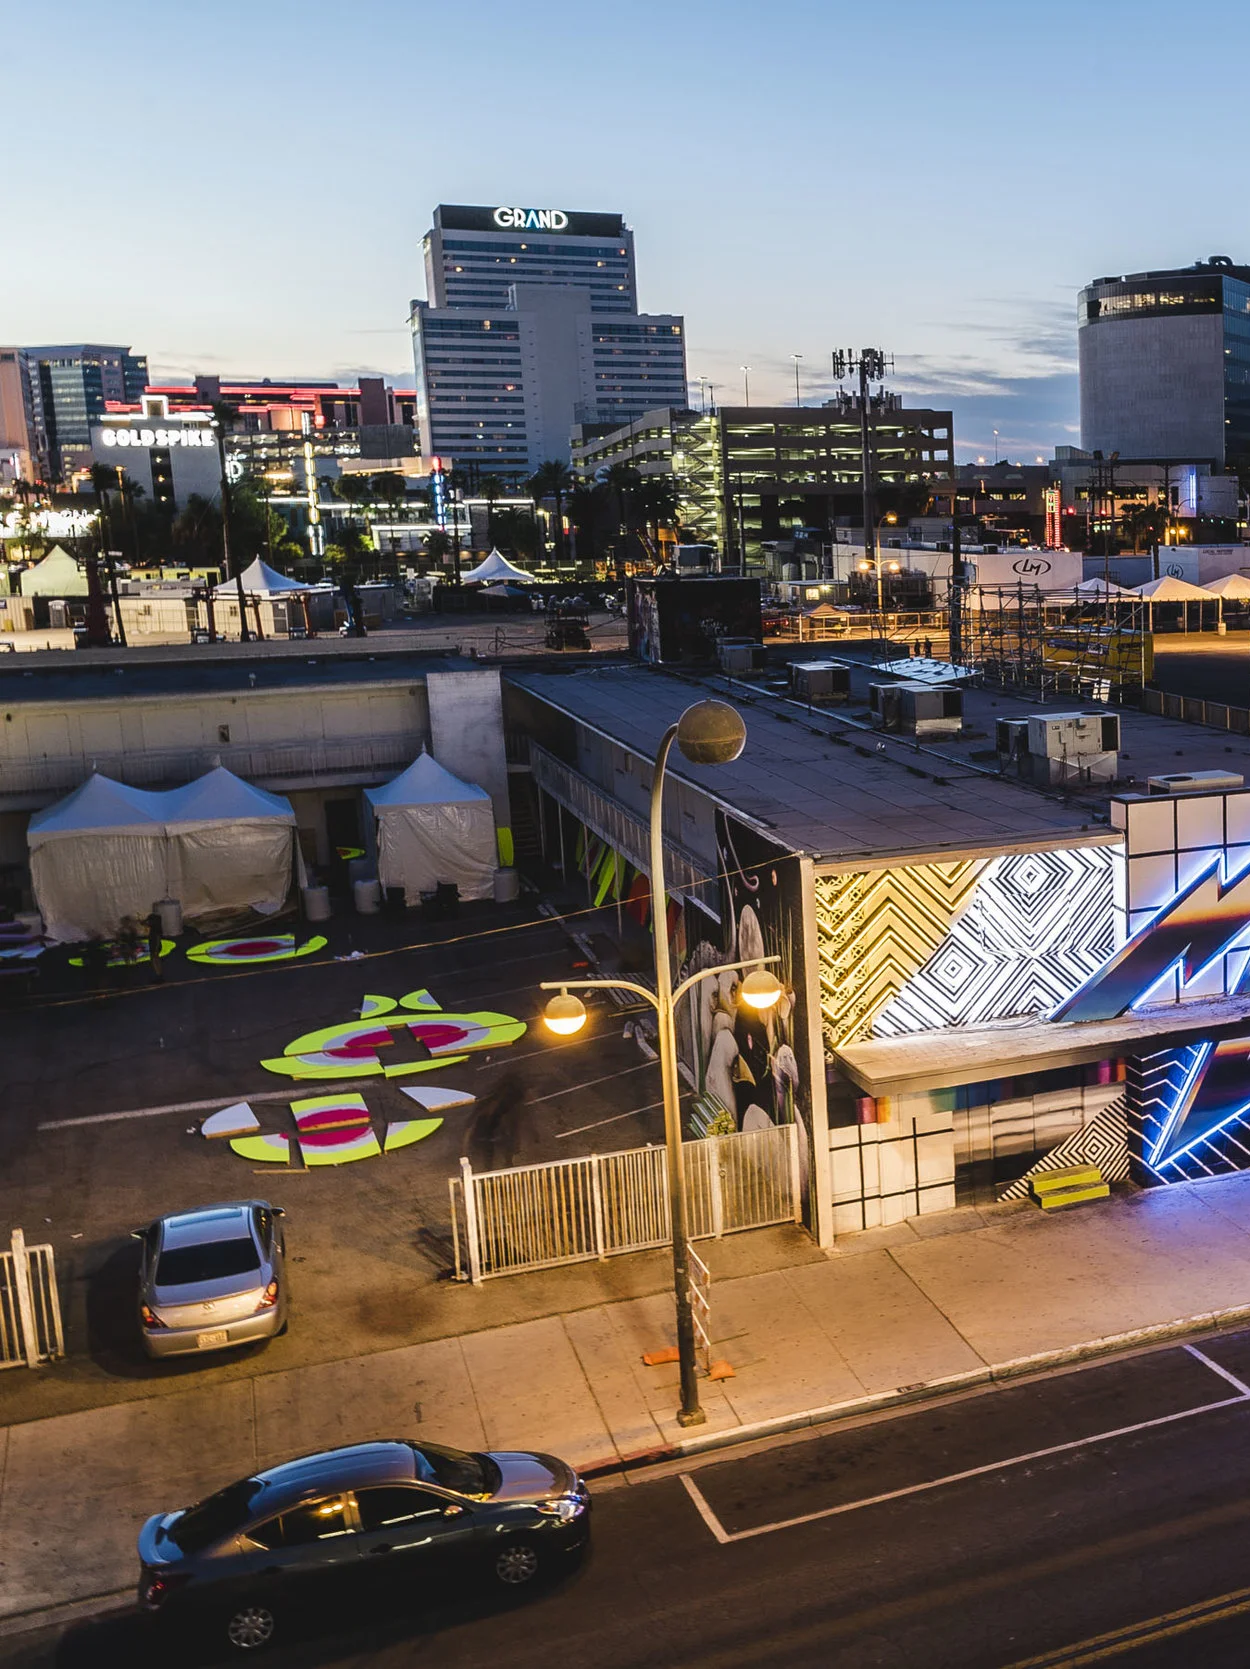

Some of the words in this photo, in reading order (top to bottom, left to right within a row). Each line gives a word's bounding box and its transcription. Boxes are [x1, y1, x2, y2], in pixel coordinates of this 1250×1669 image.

[493, 206, 568, 229] GRAND
[102, 428, 155, 447] GOLD
[155, 428, 215, 447] SPIKE
